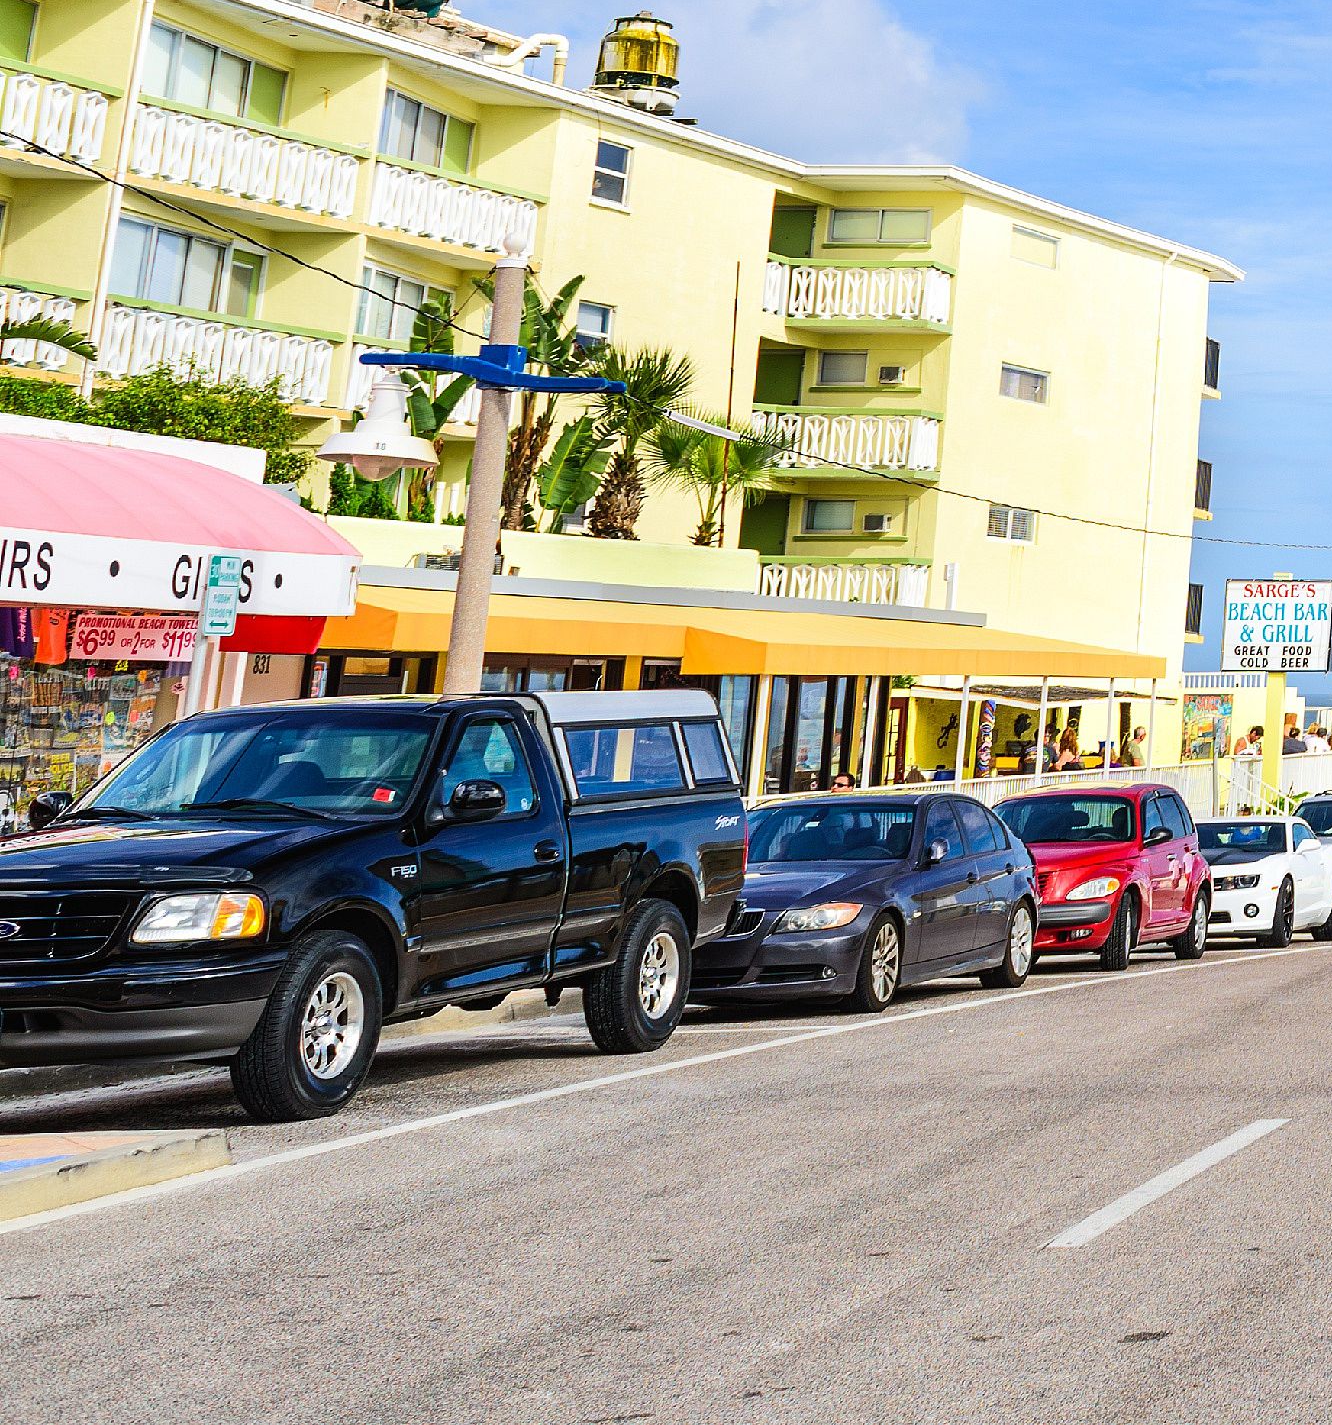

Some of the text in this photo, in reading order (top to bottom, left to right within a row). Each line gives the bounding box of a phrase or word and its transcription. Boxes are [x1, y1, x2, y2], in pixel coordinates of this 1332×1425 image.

[172, 554, 254, 604] GIS
[1243, 583, 1316, 598] SARGE'S
[1227, 602, 1328, 621] BEACH BAR
[78, 617, 136, 629] PROMOTIONAL
[138, 618, 167, 630] BEACH
[131, 631, 141, 655] 2
[139, 639, 156, 649] FOR
[1239, 624, 1314, 643] & GRILL
[1234, 645, 1312, 656] GREAT FOOD
[252, 655, 271, 674] 831
[1240, 657, 1309, 668] COLD BEER
